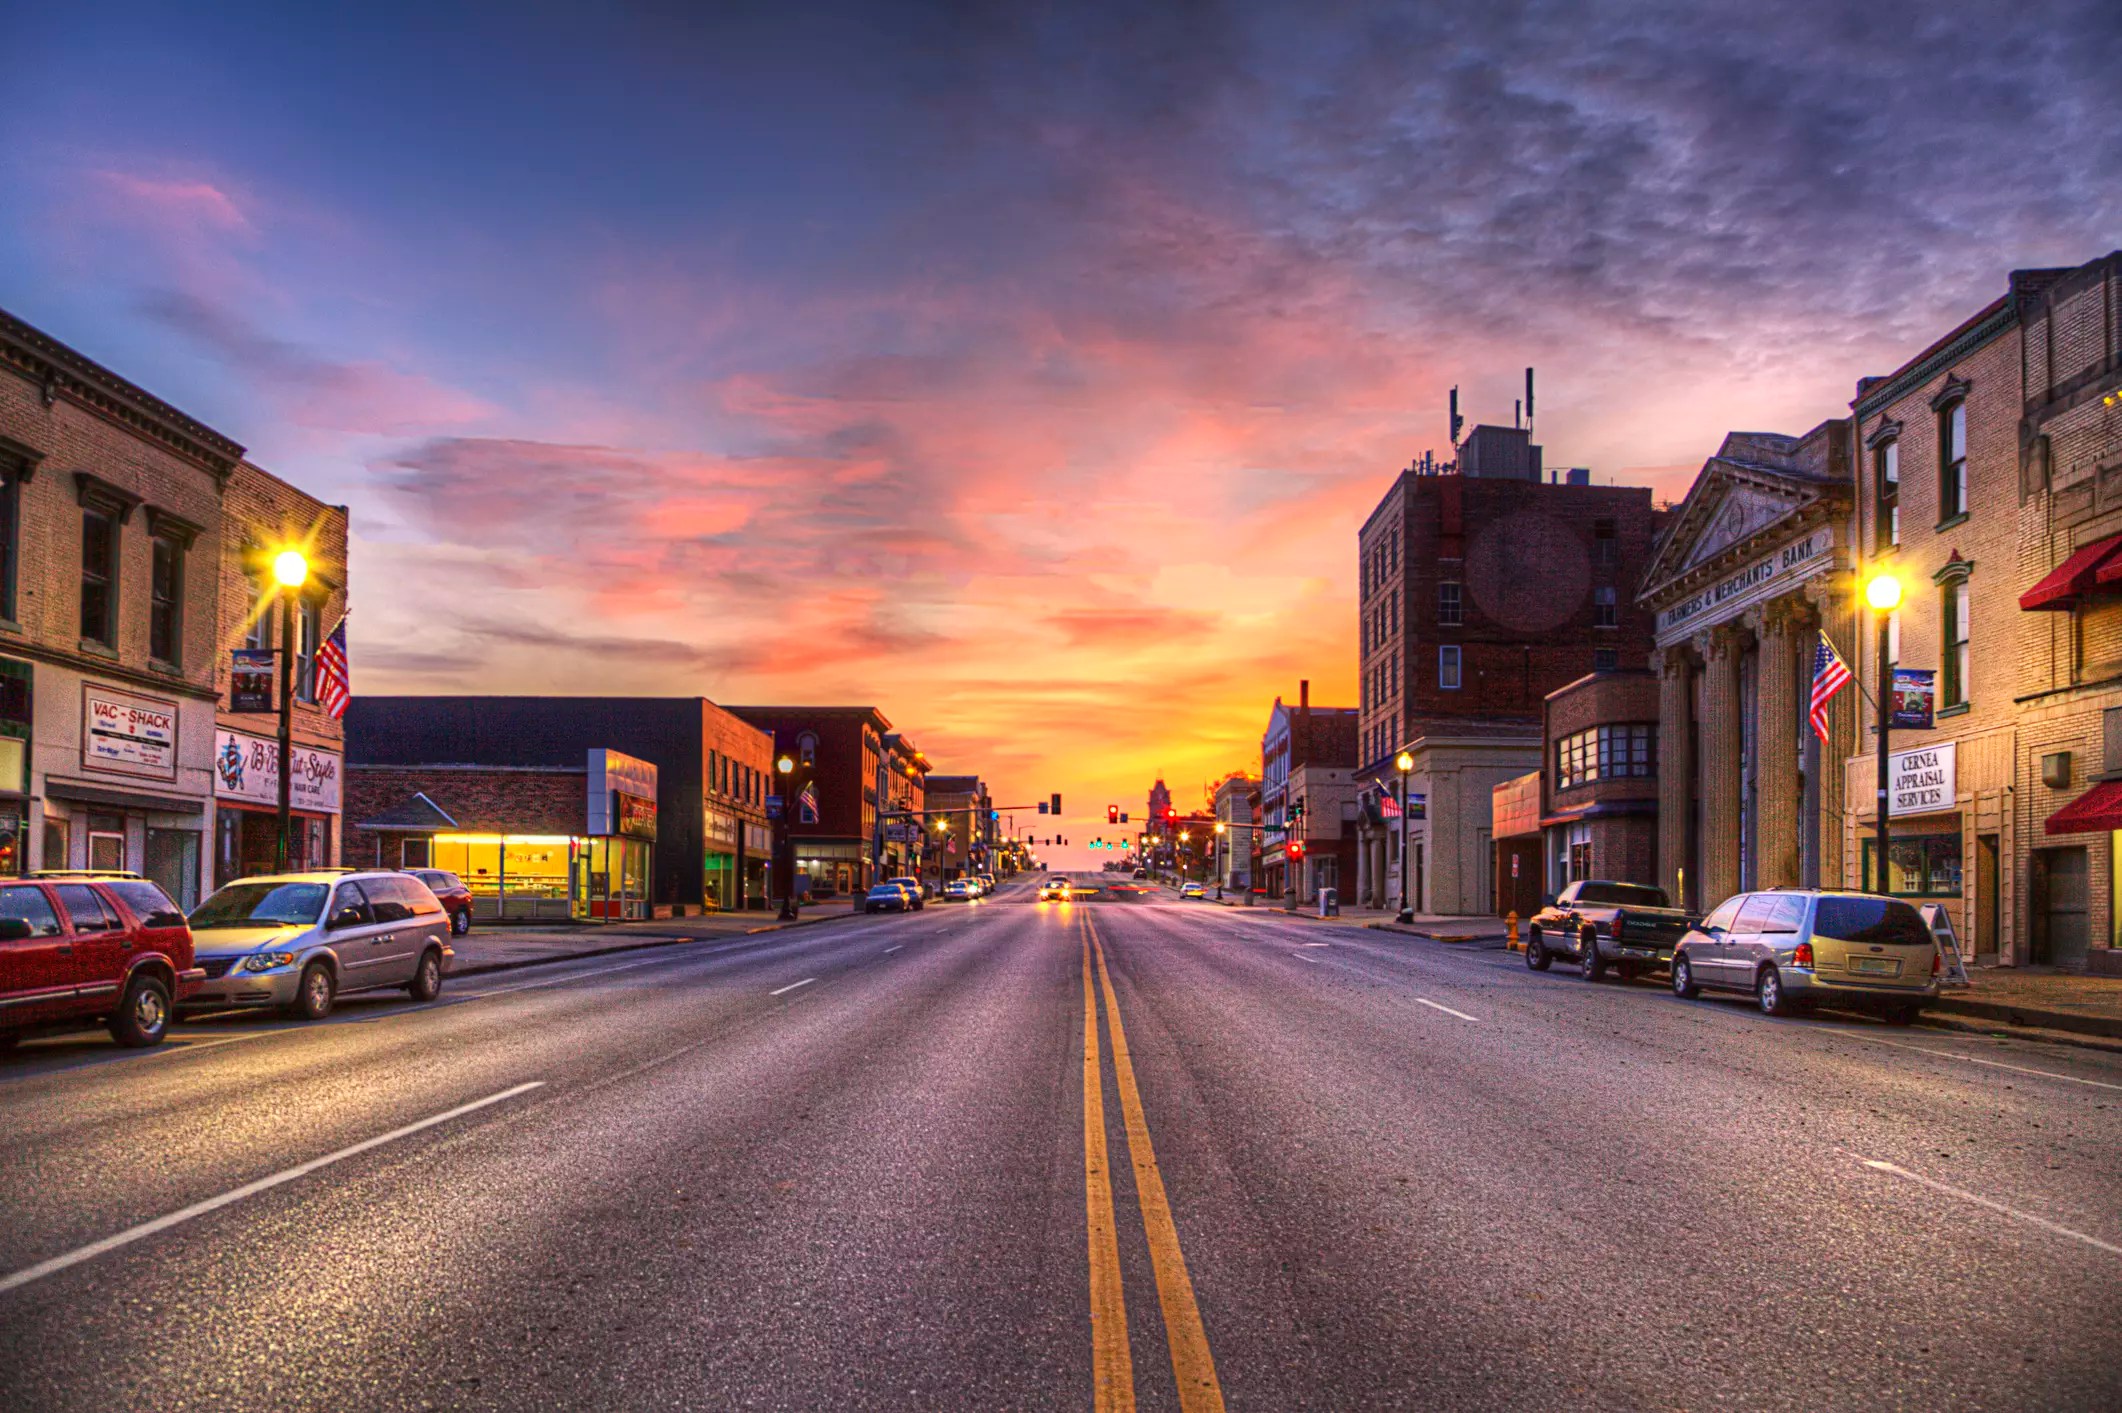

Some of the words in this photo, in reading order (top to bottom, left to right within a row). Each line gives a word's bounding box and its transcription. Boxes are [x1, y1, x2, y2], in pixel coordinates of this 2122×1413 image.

[1668, 599, 1703, 625] FARMERS
[1783, 537, 1814, 568] BANK
[94, 701, 118, 719] VAC
[128, 709, 170, 729] SHACK
[306, 753, 335, 786] Style
[1902, 752, 1938, 771] CERNEA
[308, 784, 320, 794] CARE
[1895, 769, 1945, 791] APPRAISAL
[1897, 788, 1941, 808] SERVICES
